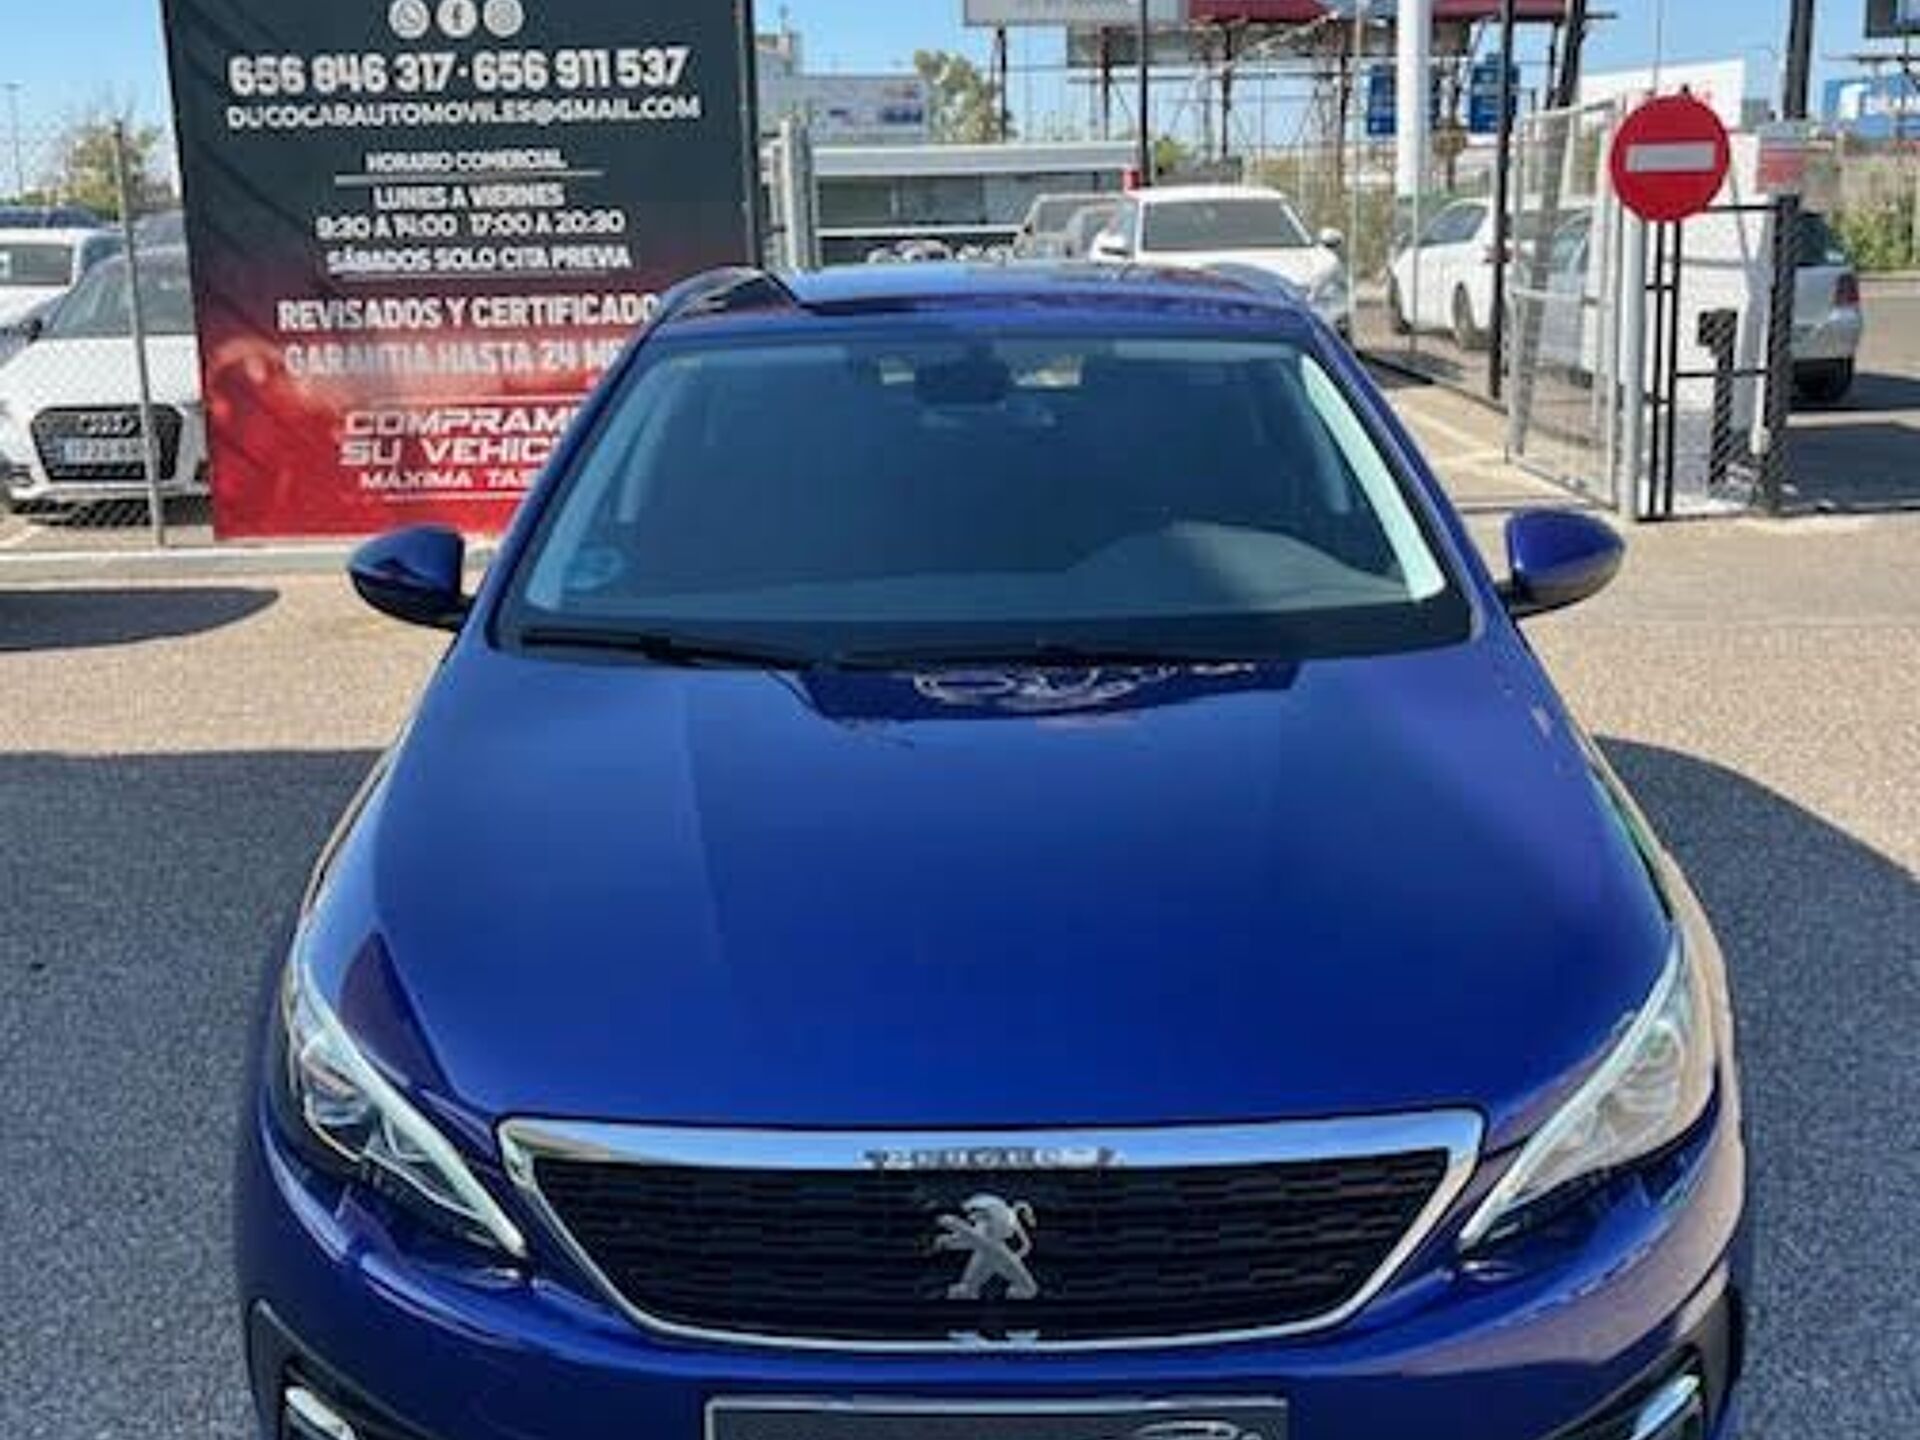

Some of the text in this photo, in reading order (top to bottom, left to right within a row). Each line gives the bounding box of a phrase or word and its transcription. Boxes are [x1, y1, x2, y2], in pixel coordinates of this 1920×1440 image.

[229, 54, 306, 96] 656
[311, 53, 388, 93] 846
[555, 48, 611, 90] 911
[615, 46, 691, 88] 537
[372, 183, 565, 209] LUNES A VIERNES
[375, 213, 393, 238] A
[536, 211, 552, 234] A
[554, 208, 626, 234] 20:30
[433, 246, 497, 272] SOLO
[500, 245, 550, 269] CITA
[551, 244, 632, 269] PREVIA
[277, 299, 442, 332] REVISADOS
[446, 297, 467, 328] Y
[437, 340, 535, 373] HASTA
[339, 436, 402, 466] SU
